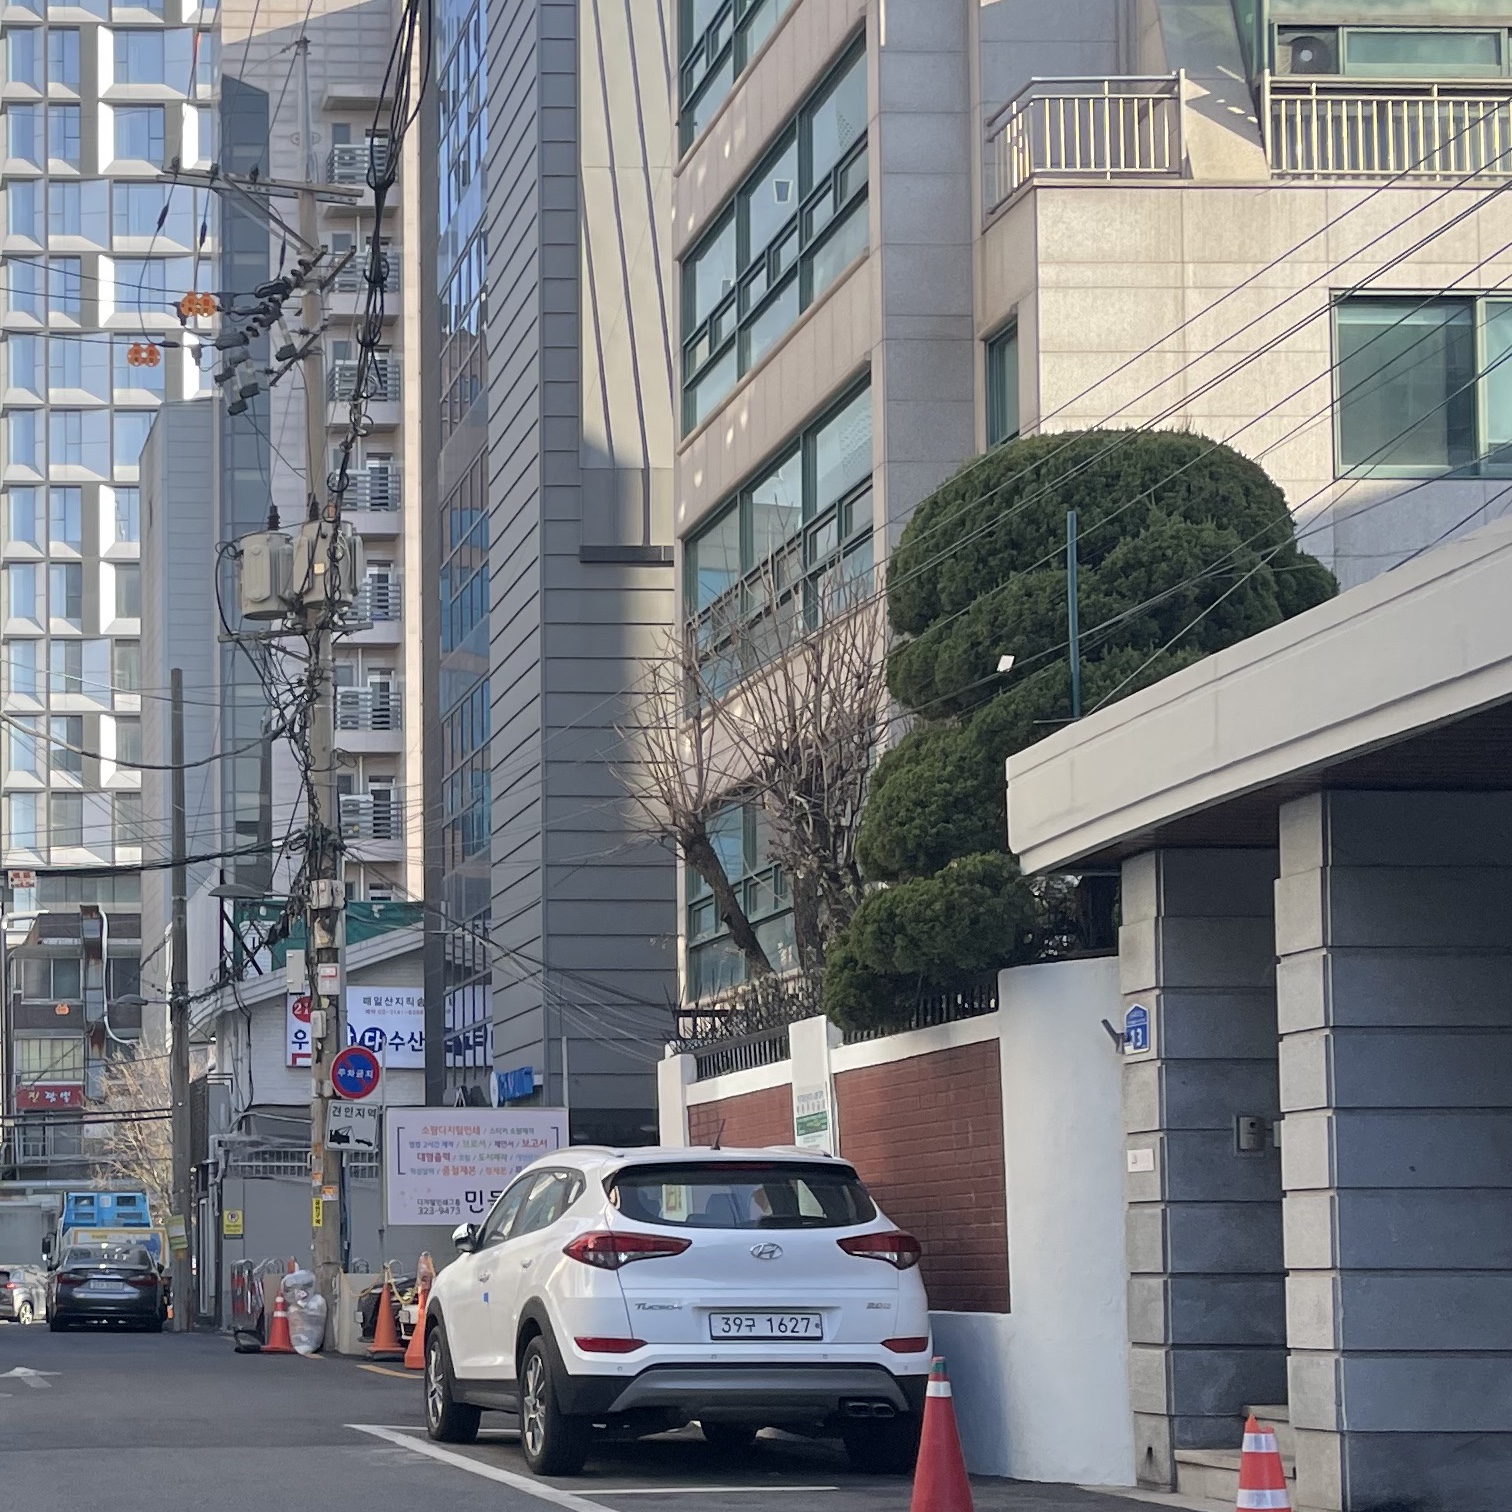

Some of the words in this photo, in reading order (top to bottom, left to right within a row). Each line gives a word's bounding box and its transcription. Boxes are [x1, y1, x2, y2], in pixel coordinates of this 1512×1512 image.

[1129, 1027, 1143, 1047] 13
[337, 1068, 374, 1079] 주차금지
[332, 1105, 377, 1119] 견인지역
[521, 1138, 548, 1149] 보고서
[417, 1206, 461, 1215] 323-9473
[721, 1316, 756, 1334] 39구
[766, 1316, 811, 1334] 1627
